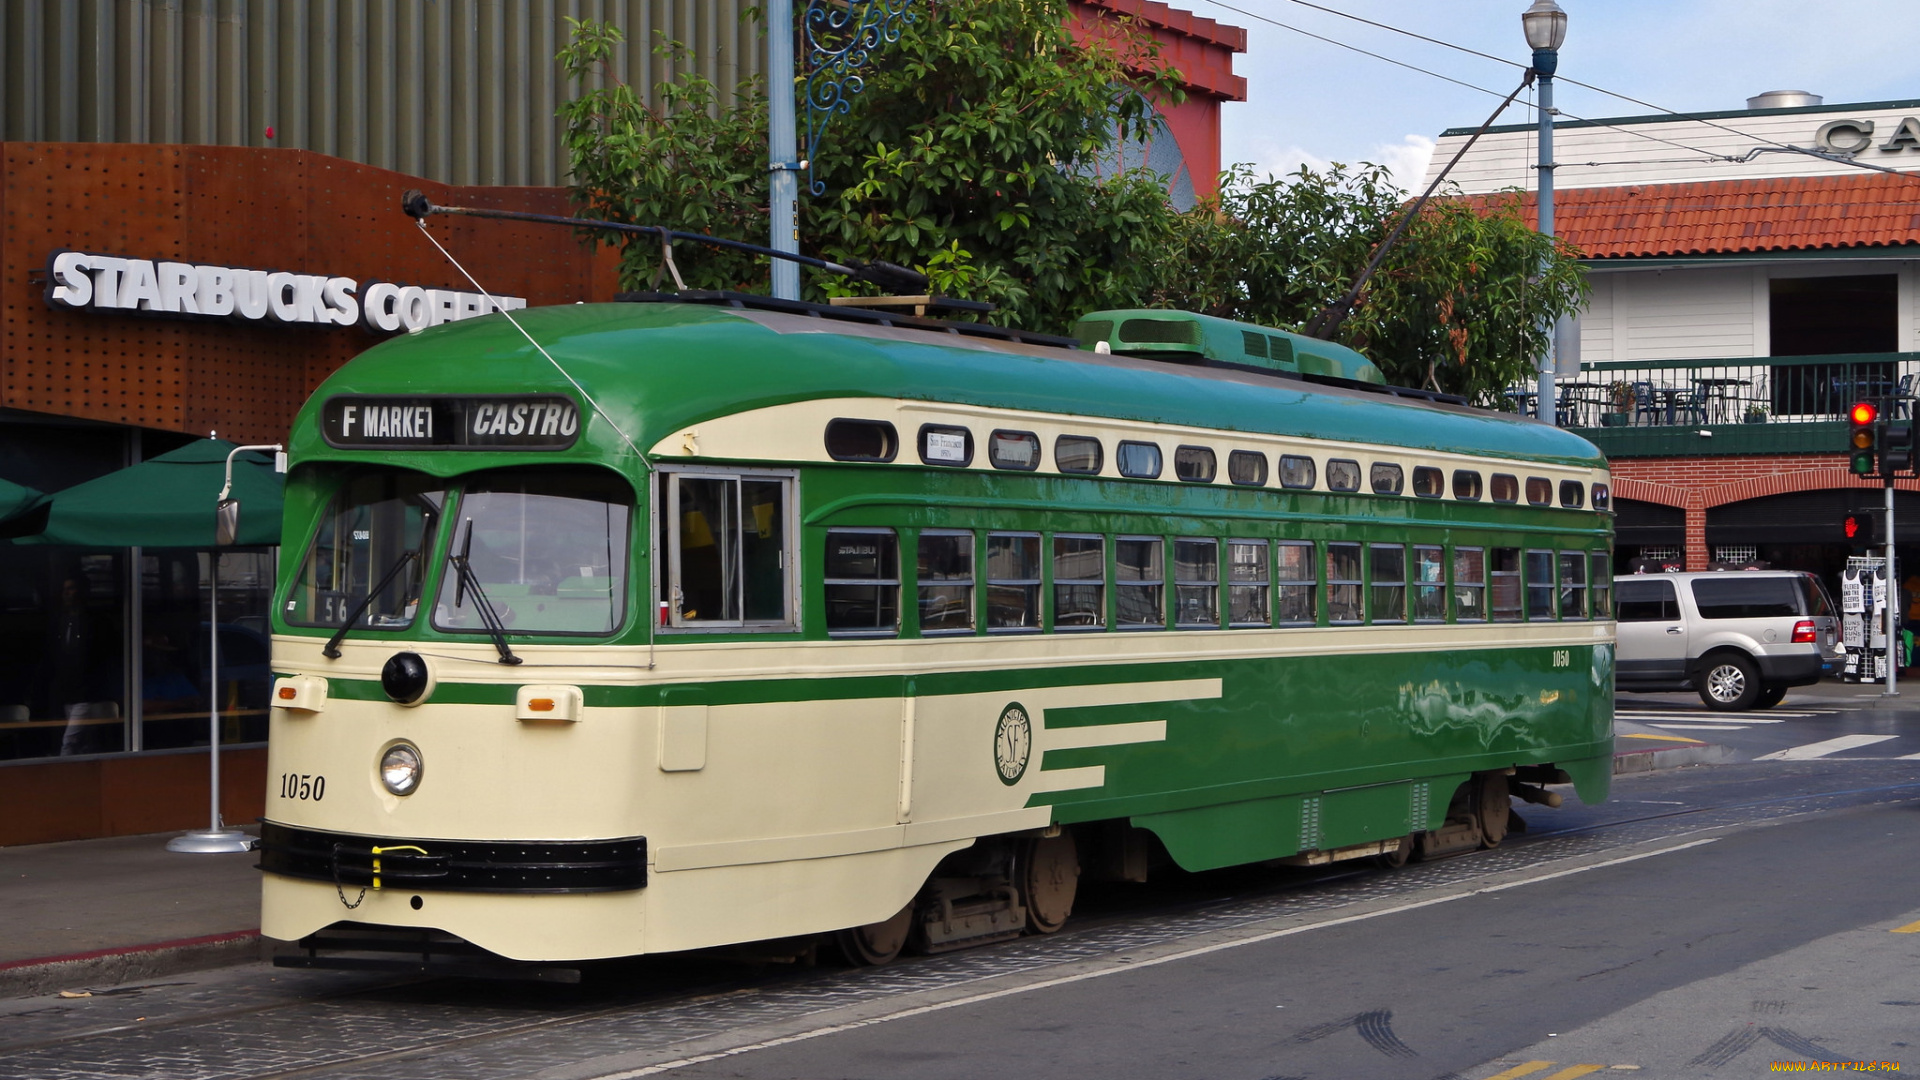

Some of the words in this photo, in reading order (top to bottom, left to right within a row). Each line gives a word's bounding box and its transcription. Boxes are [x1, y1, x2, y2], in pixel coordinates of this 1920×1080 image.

[52, 252, 358, 327] STARBUCKS
[343, 406, 356, 437] F
[473, 403, 577, 437] CASTRO
[1553, 650, 1570, 667] 1050
[280, 772, 326, 802] 1050
